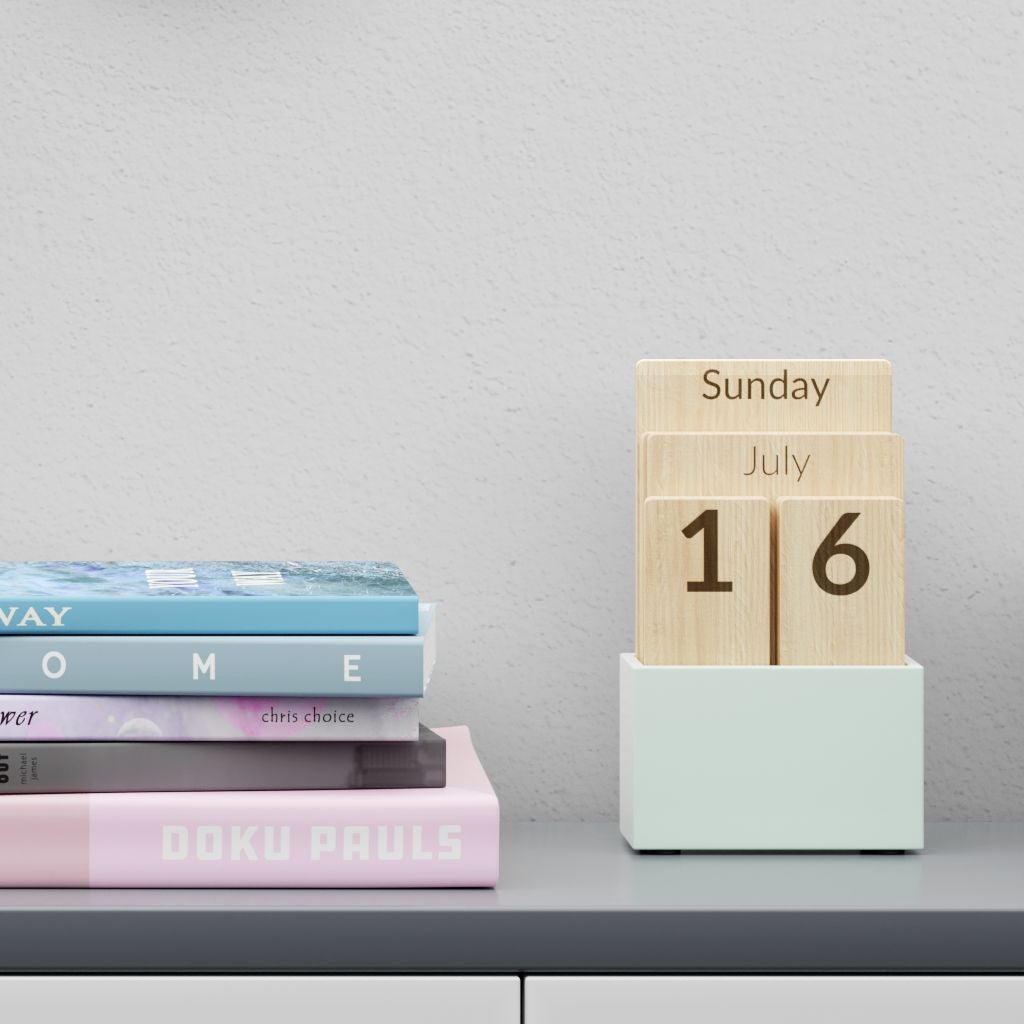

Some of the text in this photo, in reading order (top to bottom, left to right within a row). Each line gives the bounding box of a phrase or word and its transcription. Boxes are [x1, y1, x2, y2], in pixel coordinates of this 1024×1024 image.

[702, 369, 830, 407] Sunday
[743, 446, 811, 483] July
[261, 706, 355, 723] chris choice
[162, 825, 463, 861] DOKU PAULS
